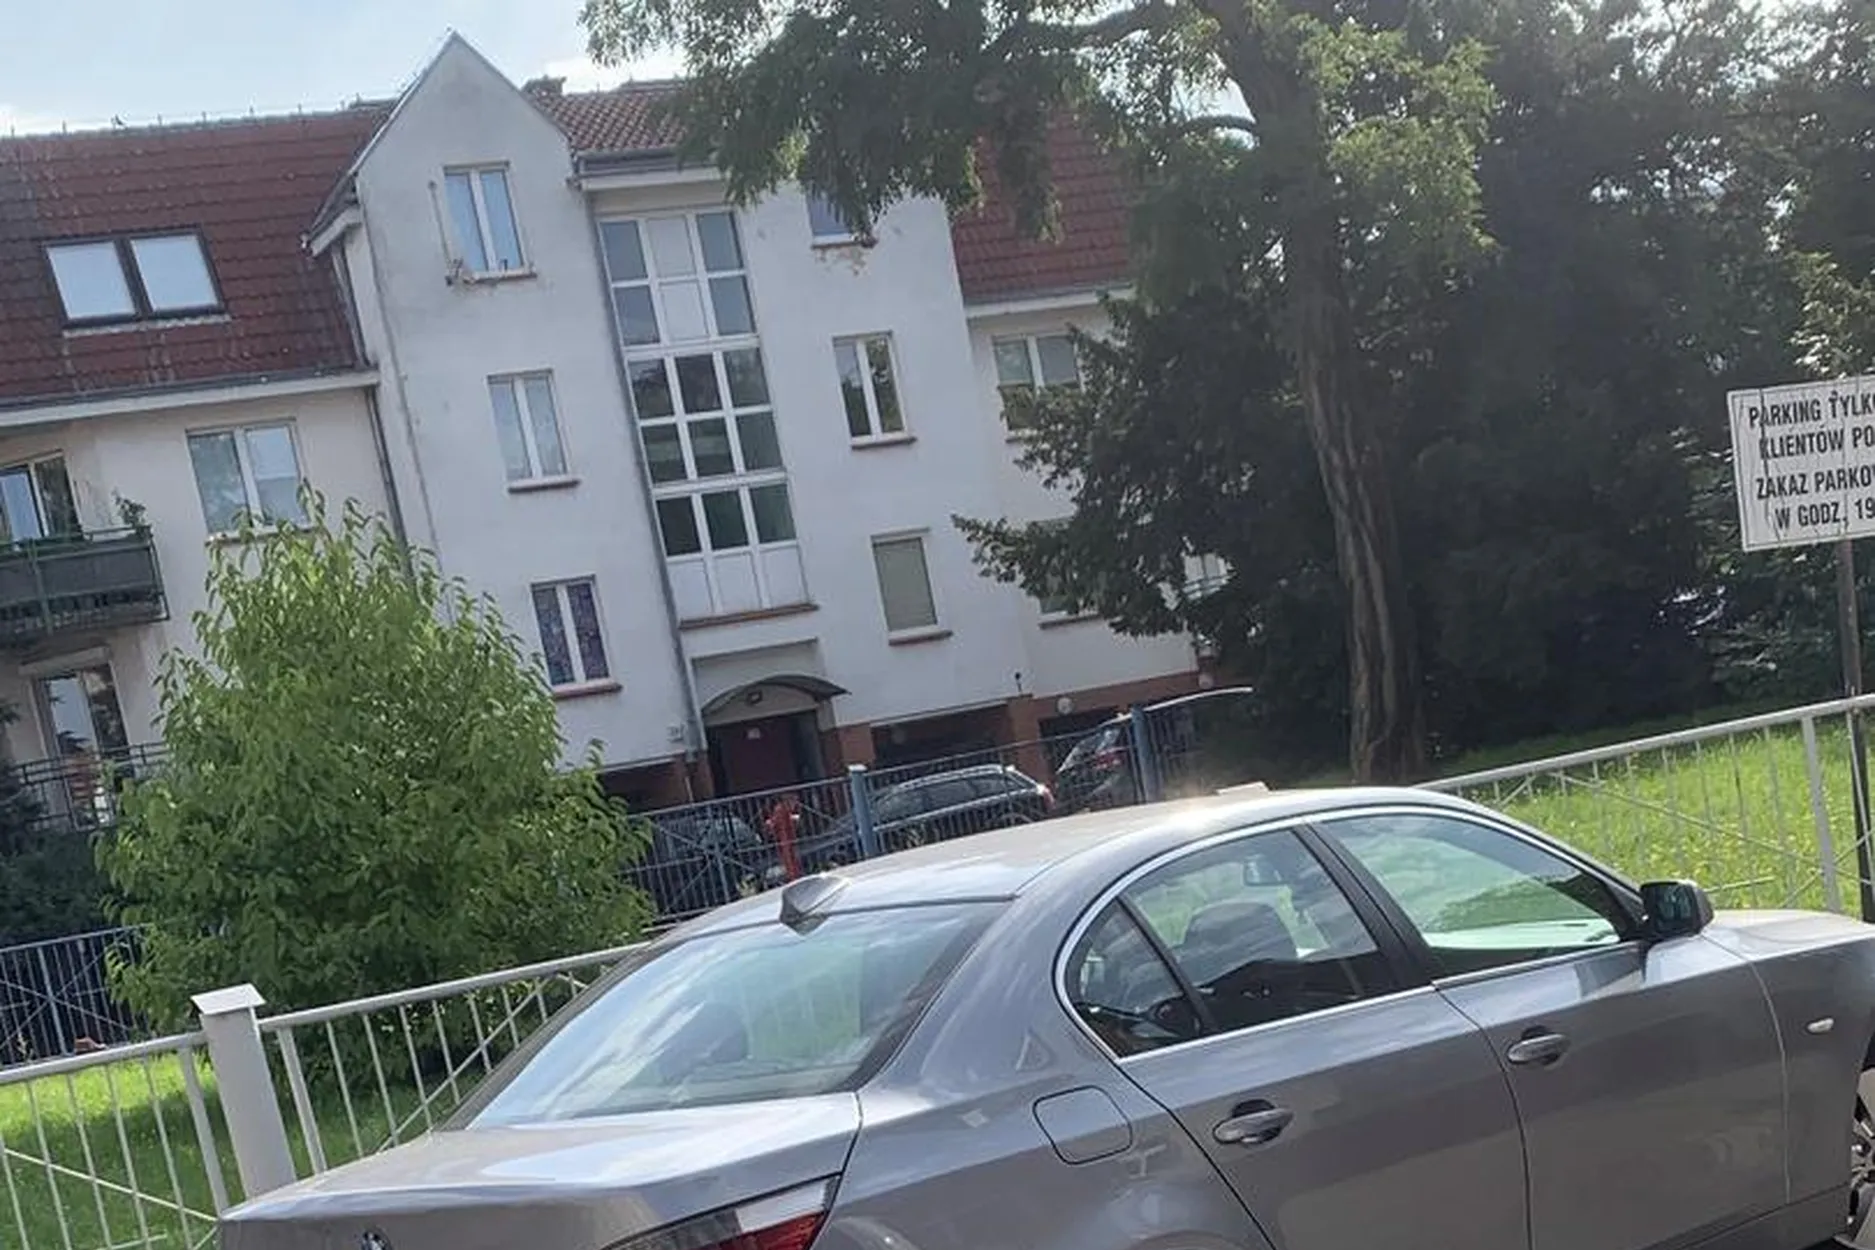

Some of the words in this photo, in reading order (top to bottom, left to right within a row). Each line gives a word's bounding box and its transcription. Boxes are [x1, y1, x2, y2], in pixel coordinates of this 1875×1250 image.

[1749, 398, 1821, 428] PARKING
[1828, 392, 1875, 418] TYLK
[1759, 424, 1845, 460] KLIENTÓW
[1756, 473, 1808, 499] ZAKAZ
[1814, 464, 1875, 493] PARKO
[1775, 507, 1791, 529] W
